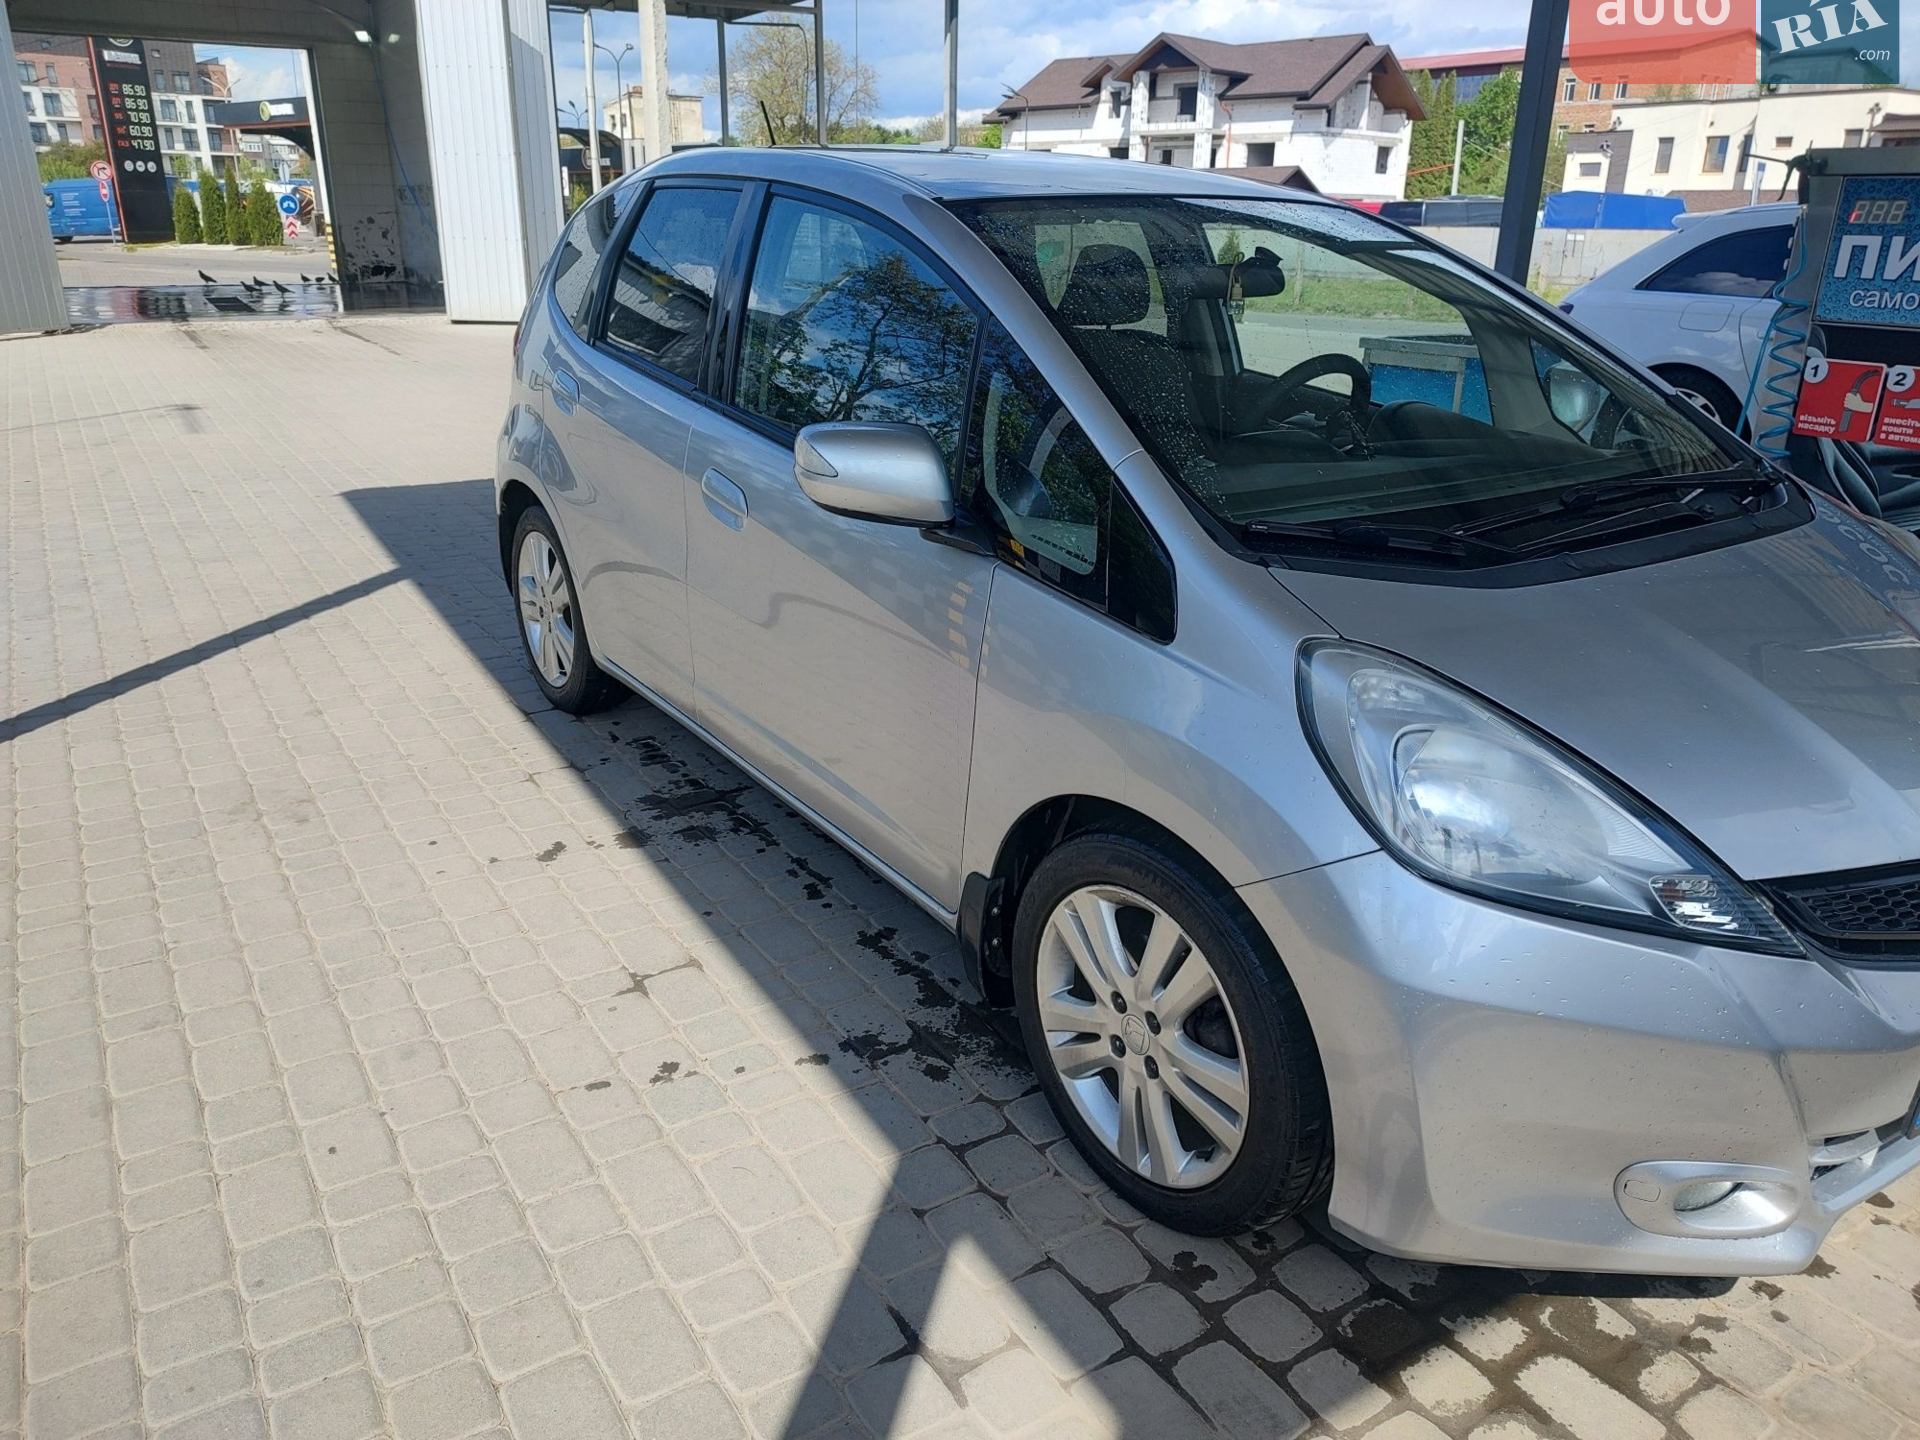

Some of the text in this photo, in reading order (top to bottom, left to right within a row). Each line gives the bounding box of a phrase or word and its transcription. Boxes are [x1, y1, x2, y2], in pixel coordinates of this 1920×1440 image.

[1810, 364, 1820, 378] 1
[1892, 372, 1907, 387] 2
[1799, 414, 1836, 425] візьміть
[1798, 422, 1836, 434] насадку
[1881, 425, 1914, 435] кошти
[1879, 432, 1887, 440] в
